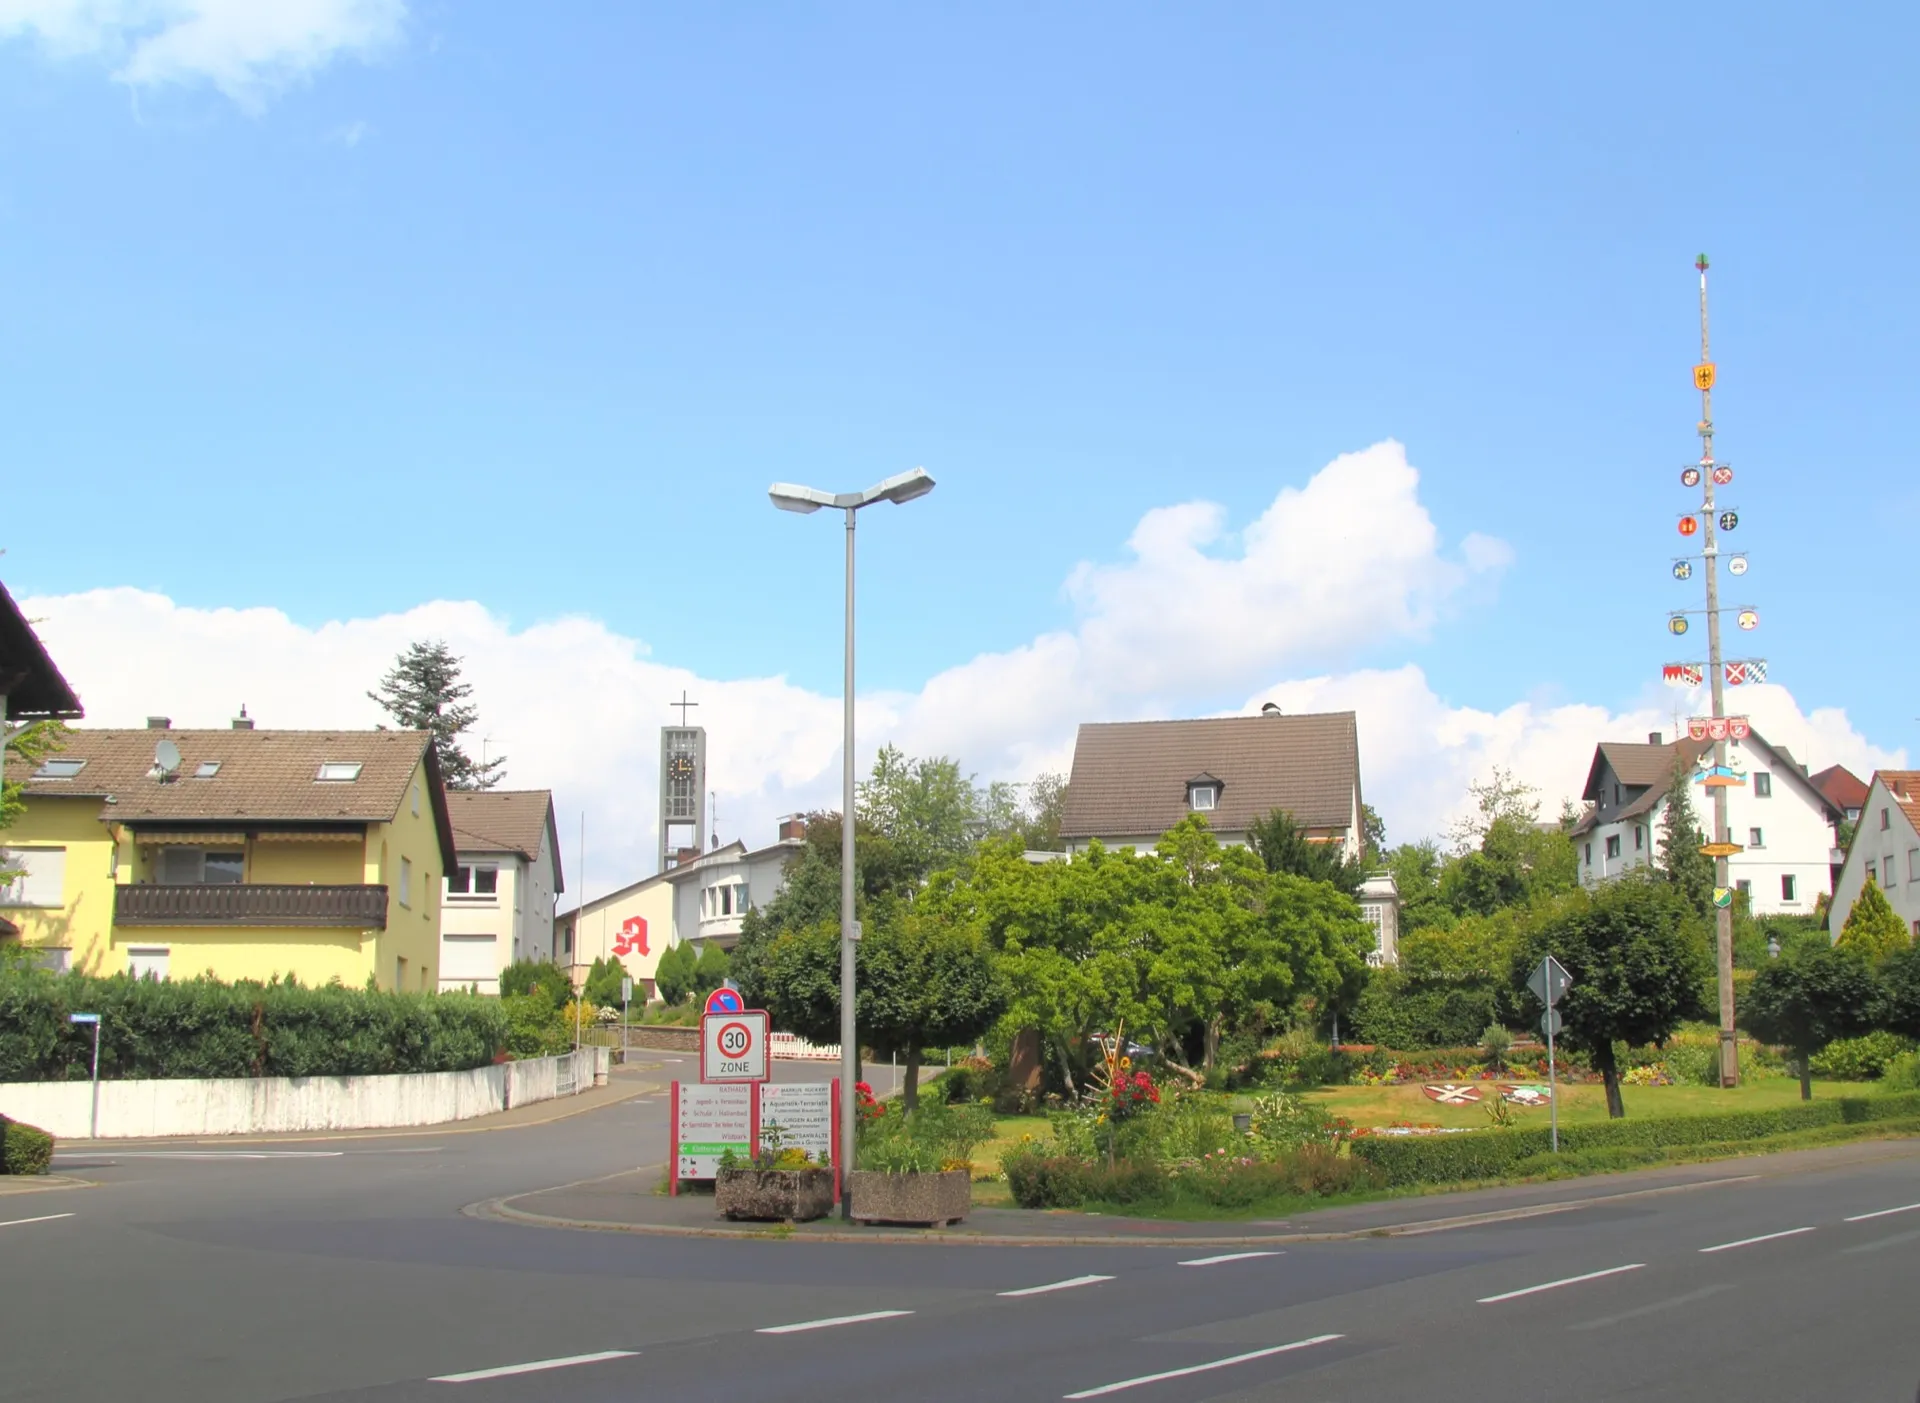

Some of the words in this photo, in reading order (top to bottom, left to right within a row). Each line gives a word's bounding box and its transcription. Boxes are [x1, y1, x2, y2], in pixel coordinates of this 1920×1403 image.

[611, 916, 651, 957] A
[725, 1032, 745, 1049] 30
[720, 1062, 750, 1073] ZONE
[719, 1085, 748, 1093] RATHAUS
[770, 1100, 828, 1108] Aquaristik-Terraristik
[693, 1109, 713, 1117] Schule
[719, 1109, 748, 1117] Hallenbad
[783, 1116, 805, 1124] JÜRGEN
[722, 1132, 748, 1140] Wildpark
